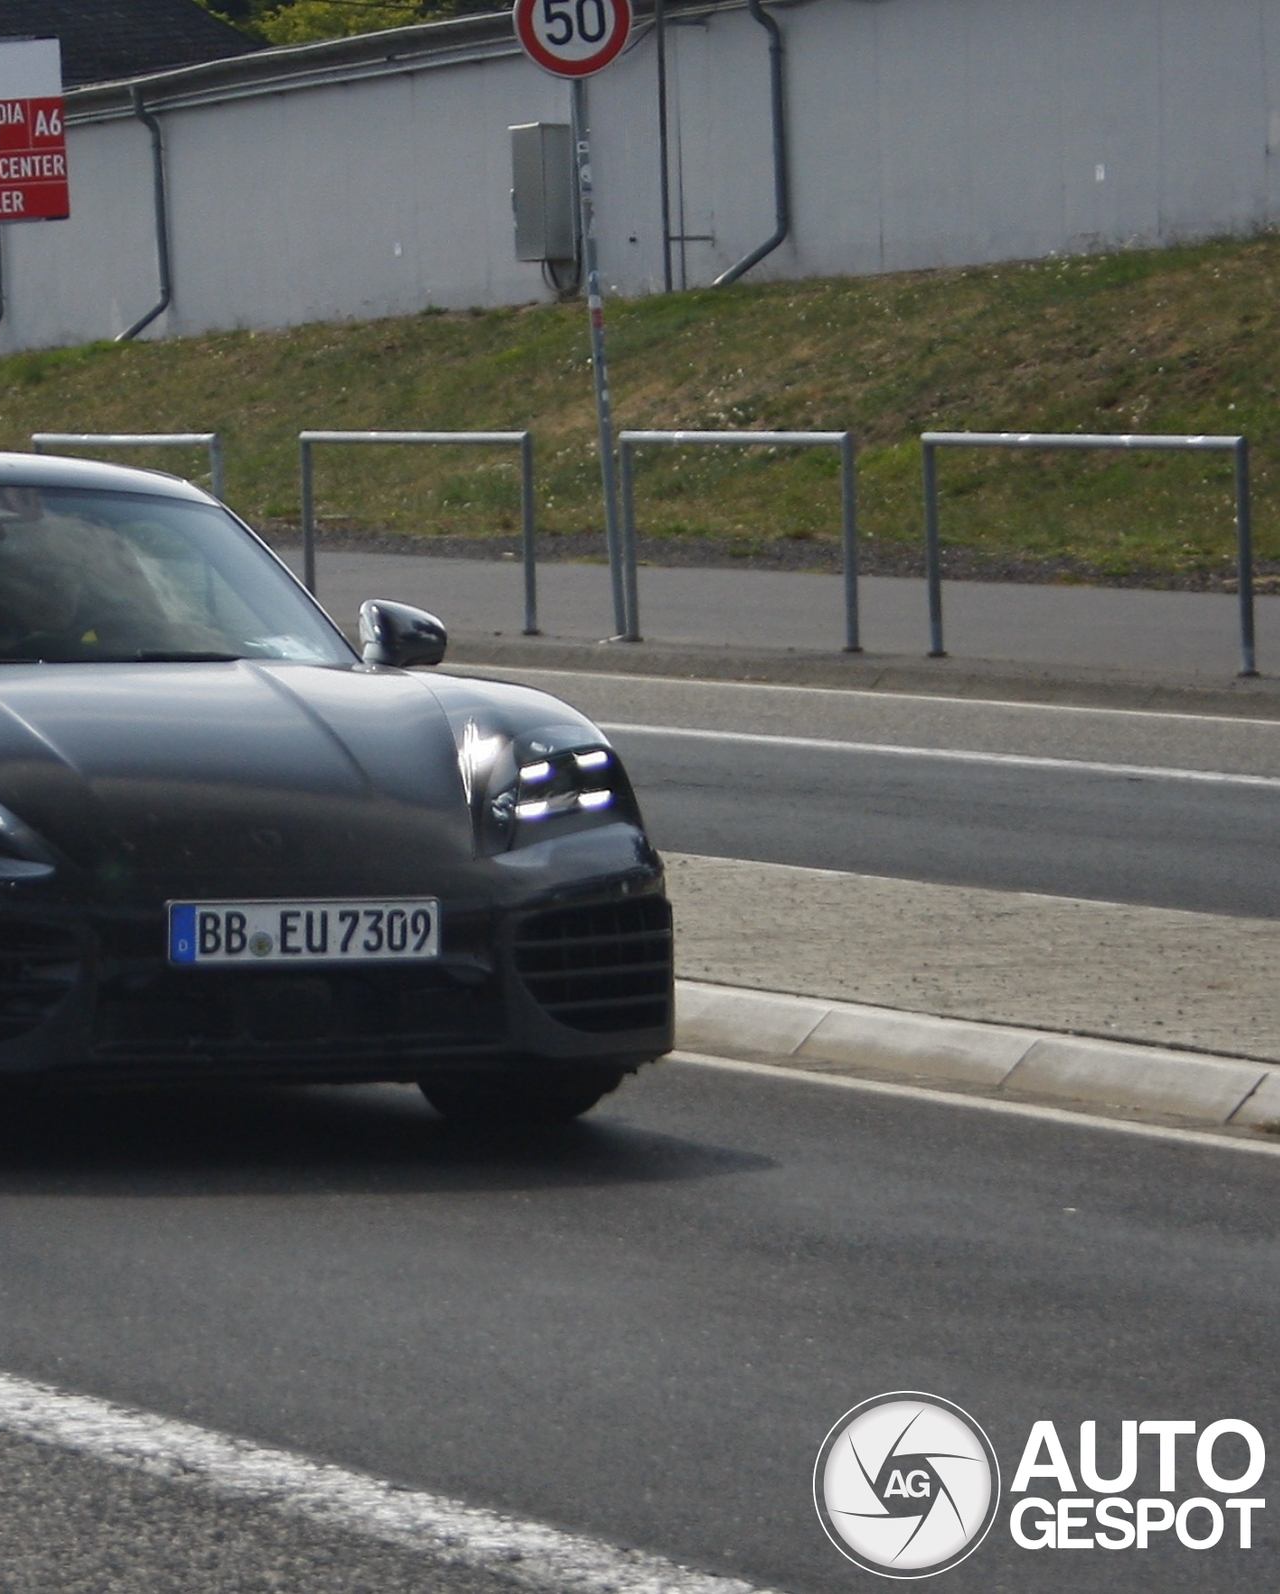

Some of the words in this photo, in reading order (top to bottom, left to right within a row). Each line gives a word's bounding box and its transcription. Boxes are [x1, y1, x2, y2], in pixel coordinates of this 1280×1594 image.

[544, 0, 606, 45] 50
[35, 109, 62, 137] A6
[178, 940, 188, 951] D
[199, 911, 247, 954] BB
[280, 910, 328, 953] EU
[338, 908, 431, 952] 7309
